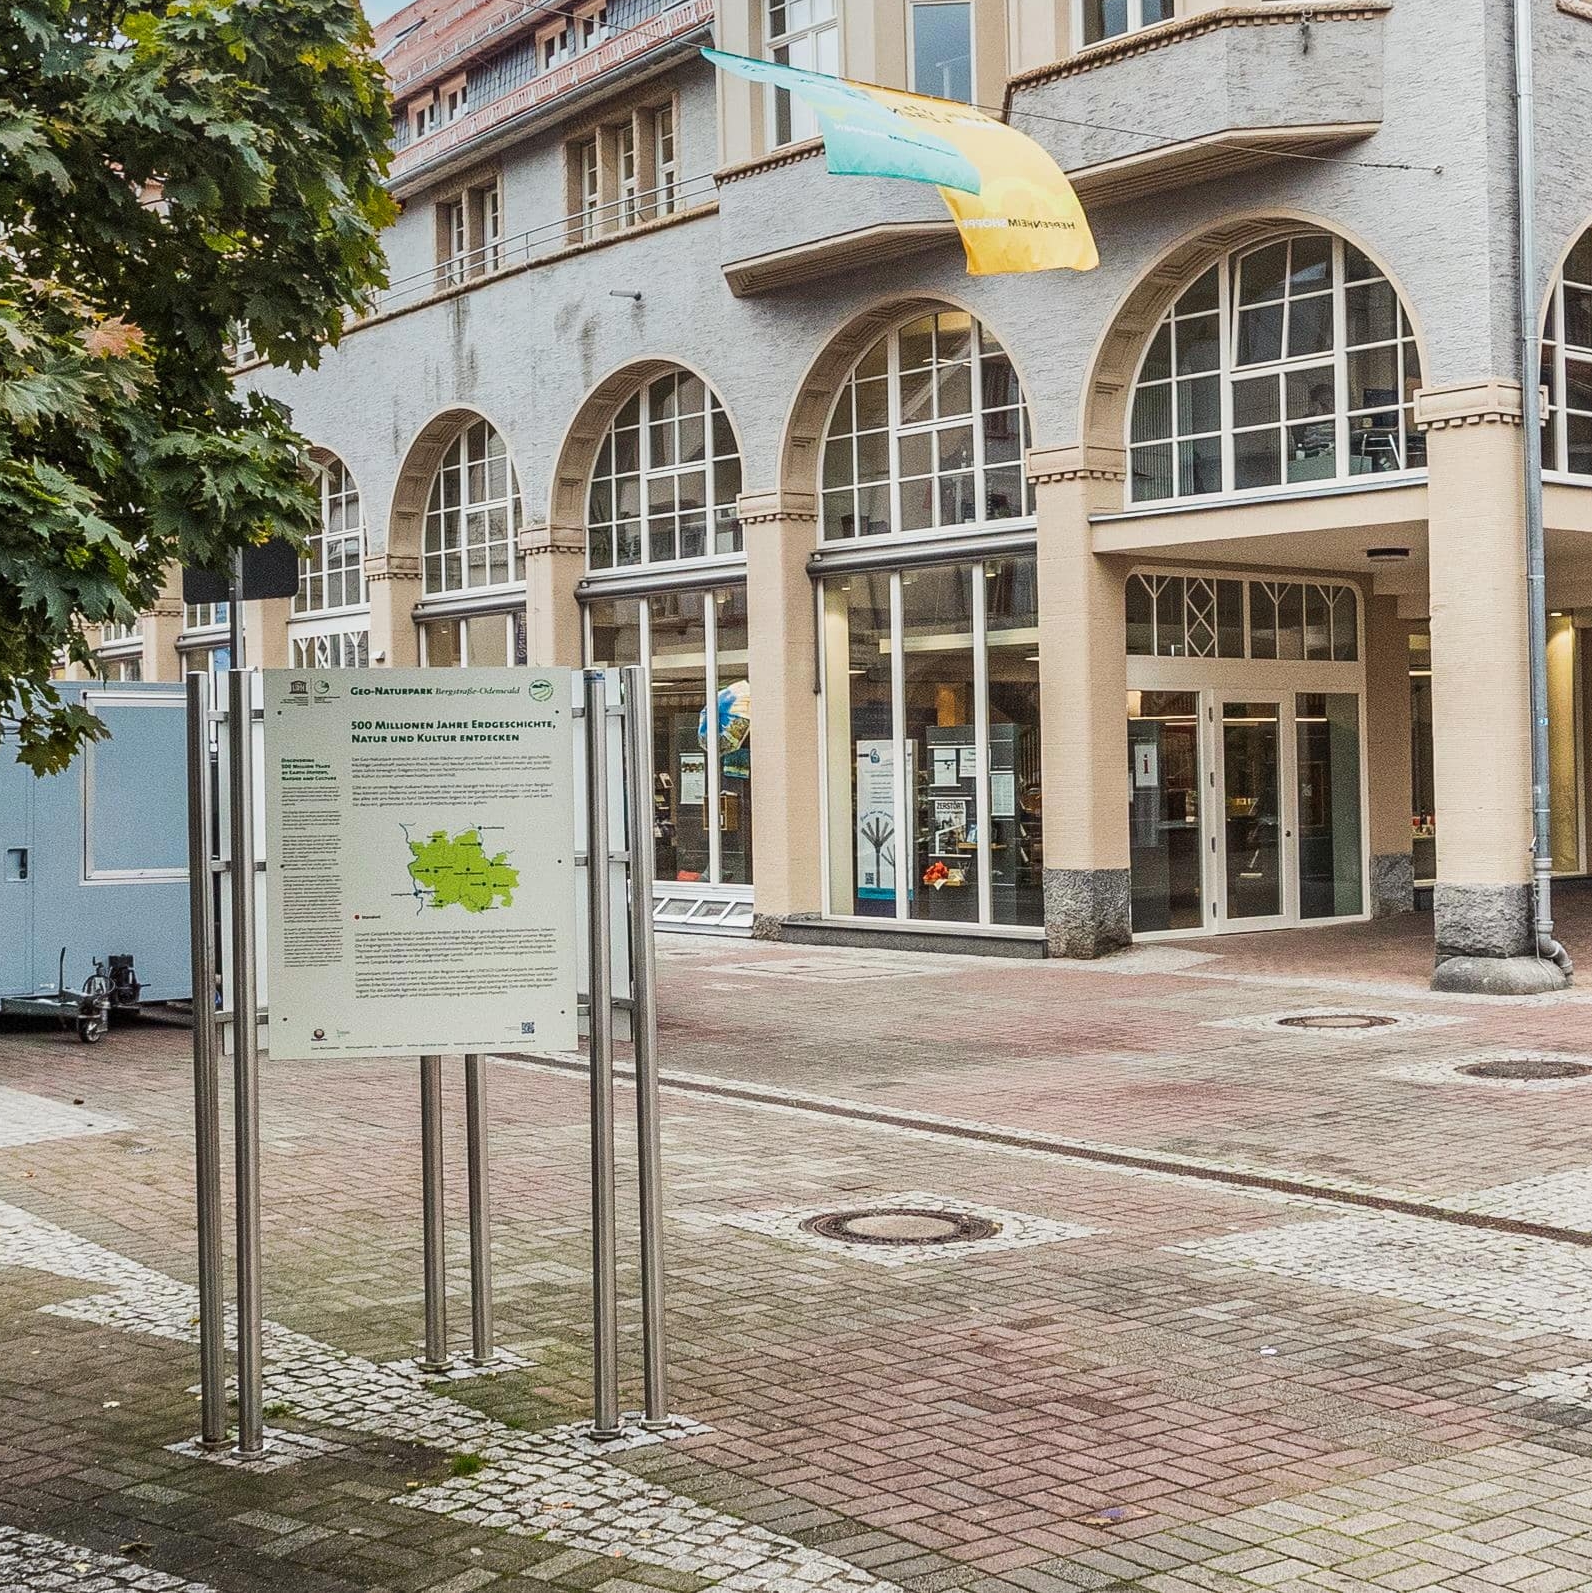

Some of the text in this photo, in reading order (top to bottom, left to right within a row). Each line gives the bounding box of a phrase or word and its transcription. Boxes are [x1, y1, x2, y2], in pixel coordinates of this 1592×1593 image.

[351, 720, 373, 730] 500
[374, 720, 434, 730] MILLIONEN
[436, 720, 469, 729] JAHRE
[351, 734, 388, 744] NATUR
[417, 733, 457, 743] KULTUR
